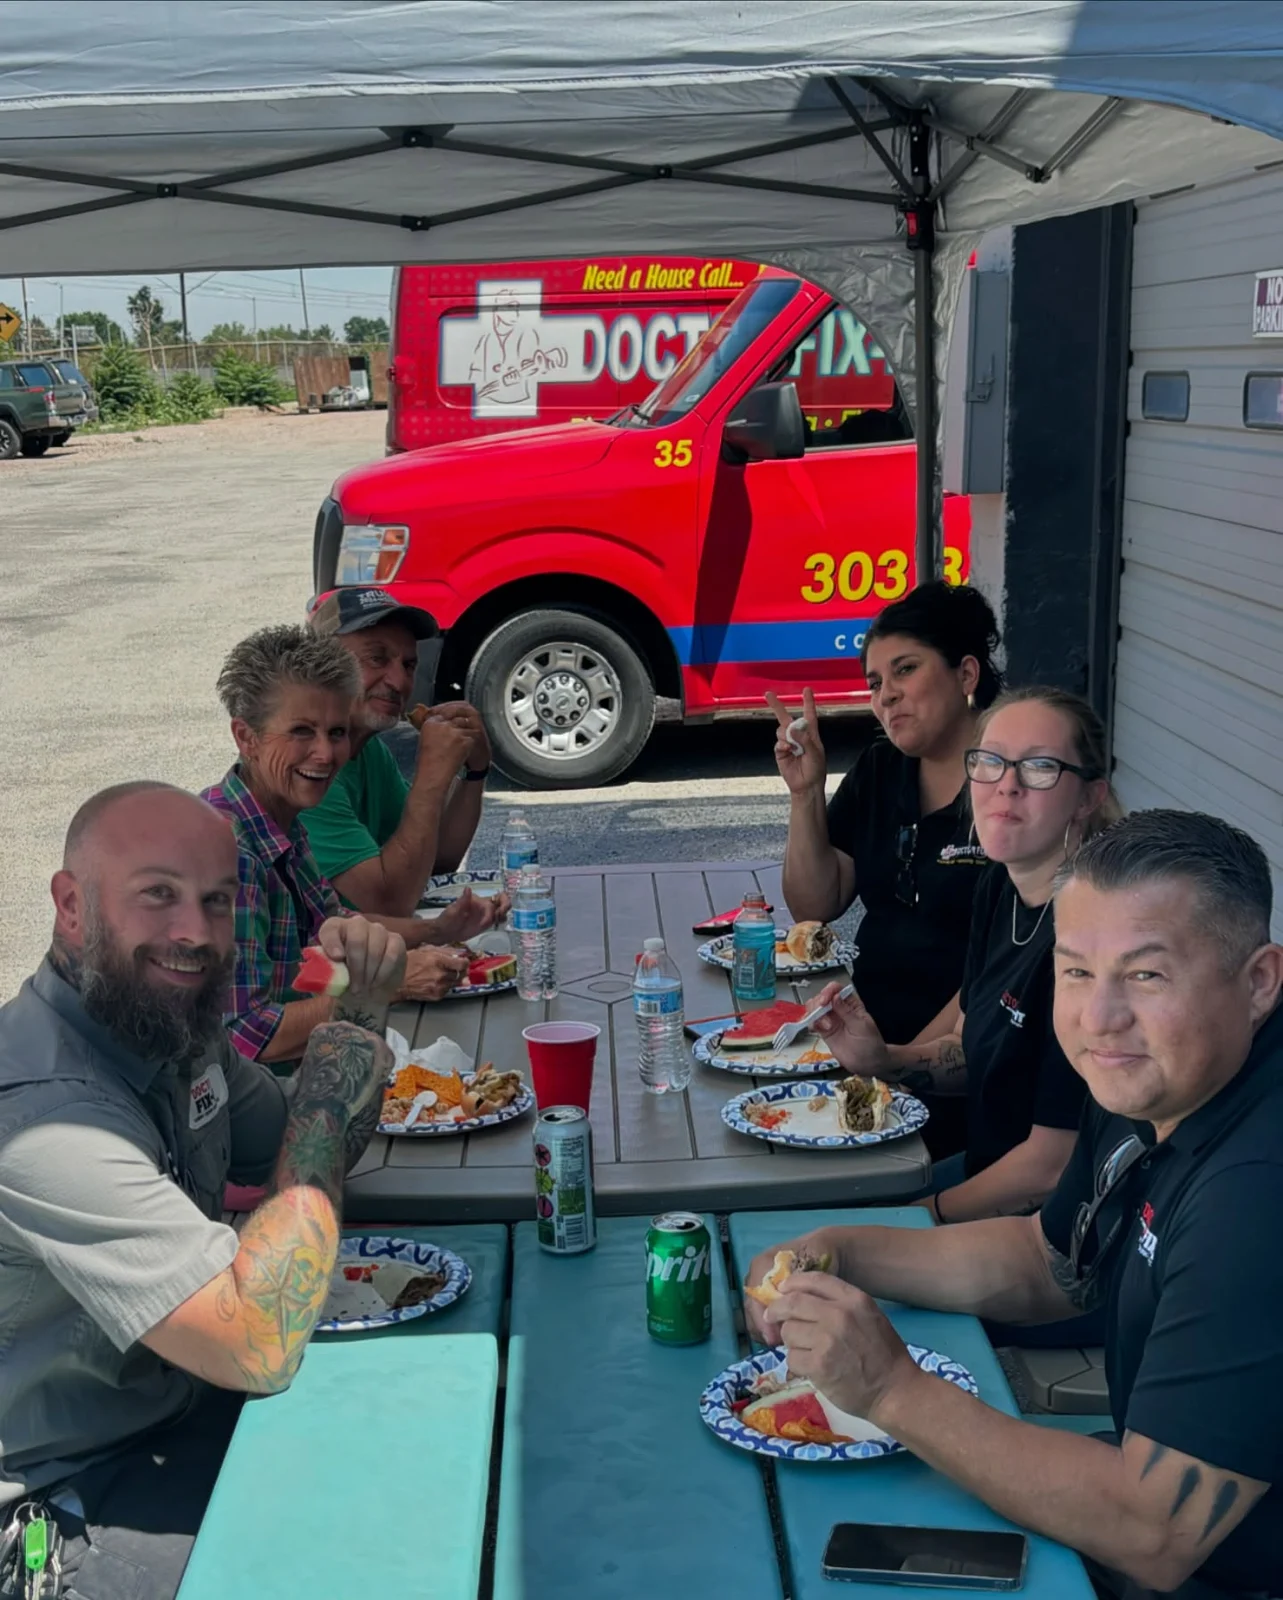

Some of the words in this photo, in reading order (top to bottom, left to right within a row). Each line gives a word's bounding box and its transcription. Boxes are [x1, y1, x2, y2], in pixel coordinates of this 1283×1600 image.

[582, 265, 627, 290] Need
[629, 269, 642, 290] a
[644, 264, 694, 290] House
[699, 263, 744, 288] Call...
[1266, 277, 1283, 305] NO
[573, 313, 711, 384] DOCT
[653, 439, 693, 468] 35
[801, 549, 909, 604] 303
[646, 1244, 711, 1283] prit
